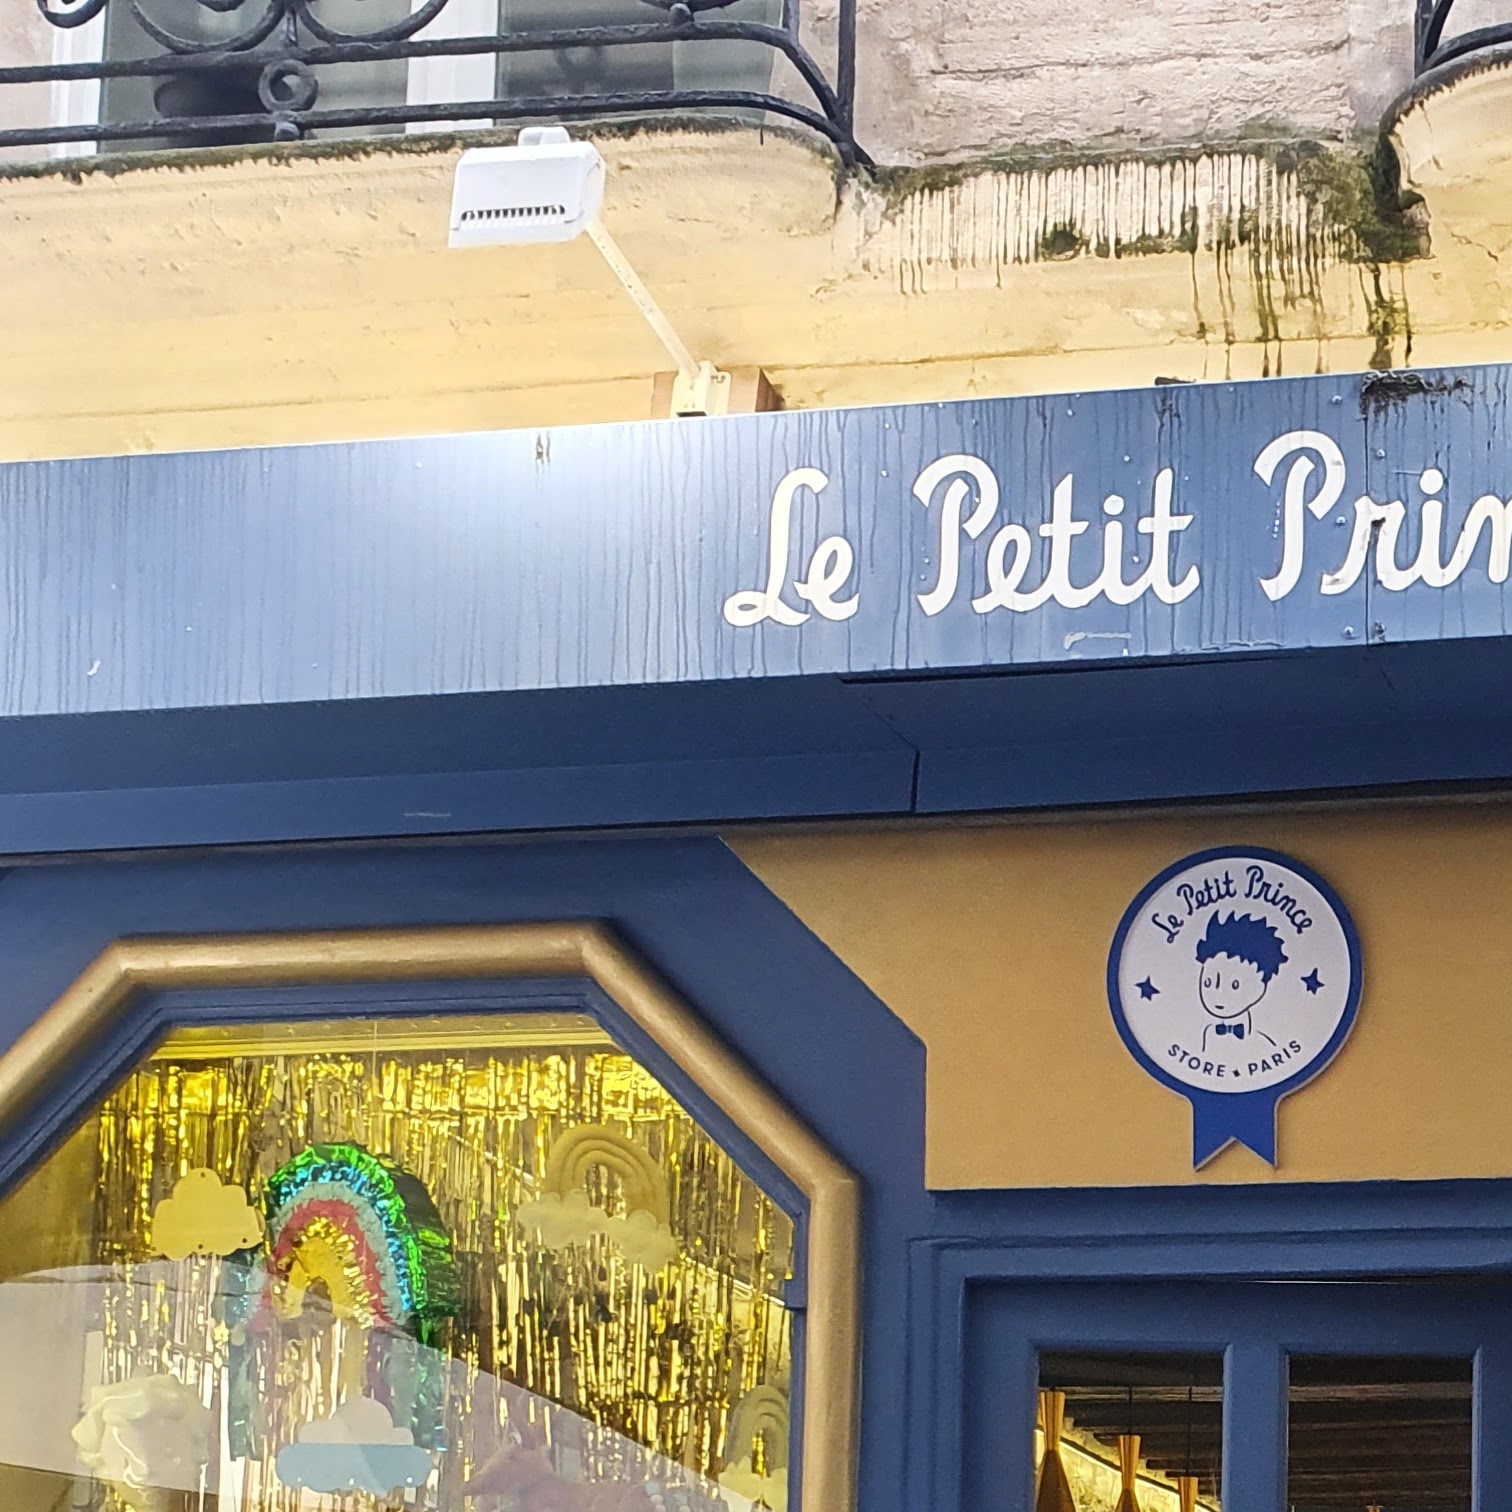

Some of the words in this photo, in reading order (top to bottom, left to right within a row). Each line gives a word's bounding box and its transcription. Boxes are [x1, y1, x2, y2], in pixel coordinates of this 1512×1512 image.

[723, 467, 860, 627] Le
[913, 454, 1200, 617] Petit
[1151, 910, 1184, 943] Le
[1176, 870, 1237, 917] Petit
[1245, 865, 1313, 934] Prince
[1167, 1043, 1226, 1078] STORE
[1247, 1040, 1302, 1077] PARIS
